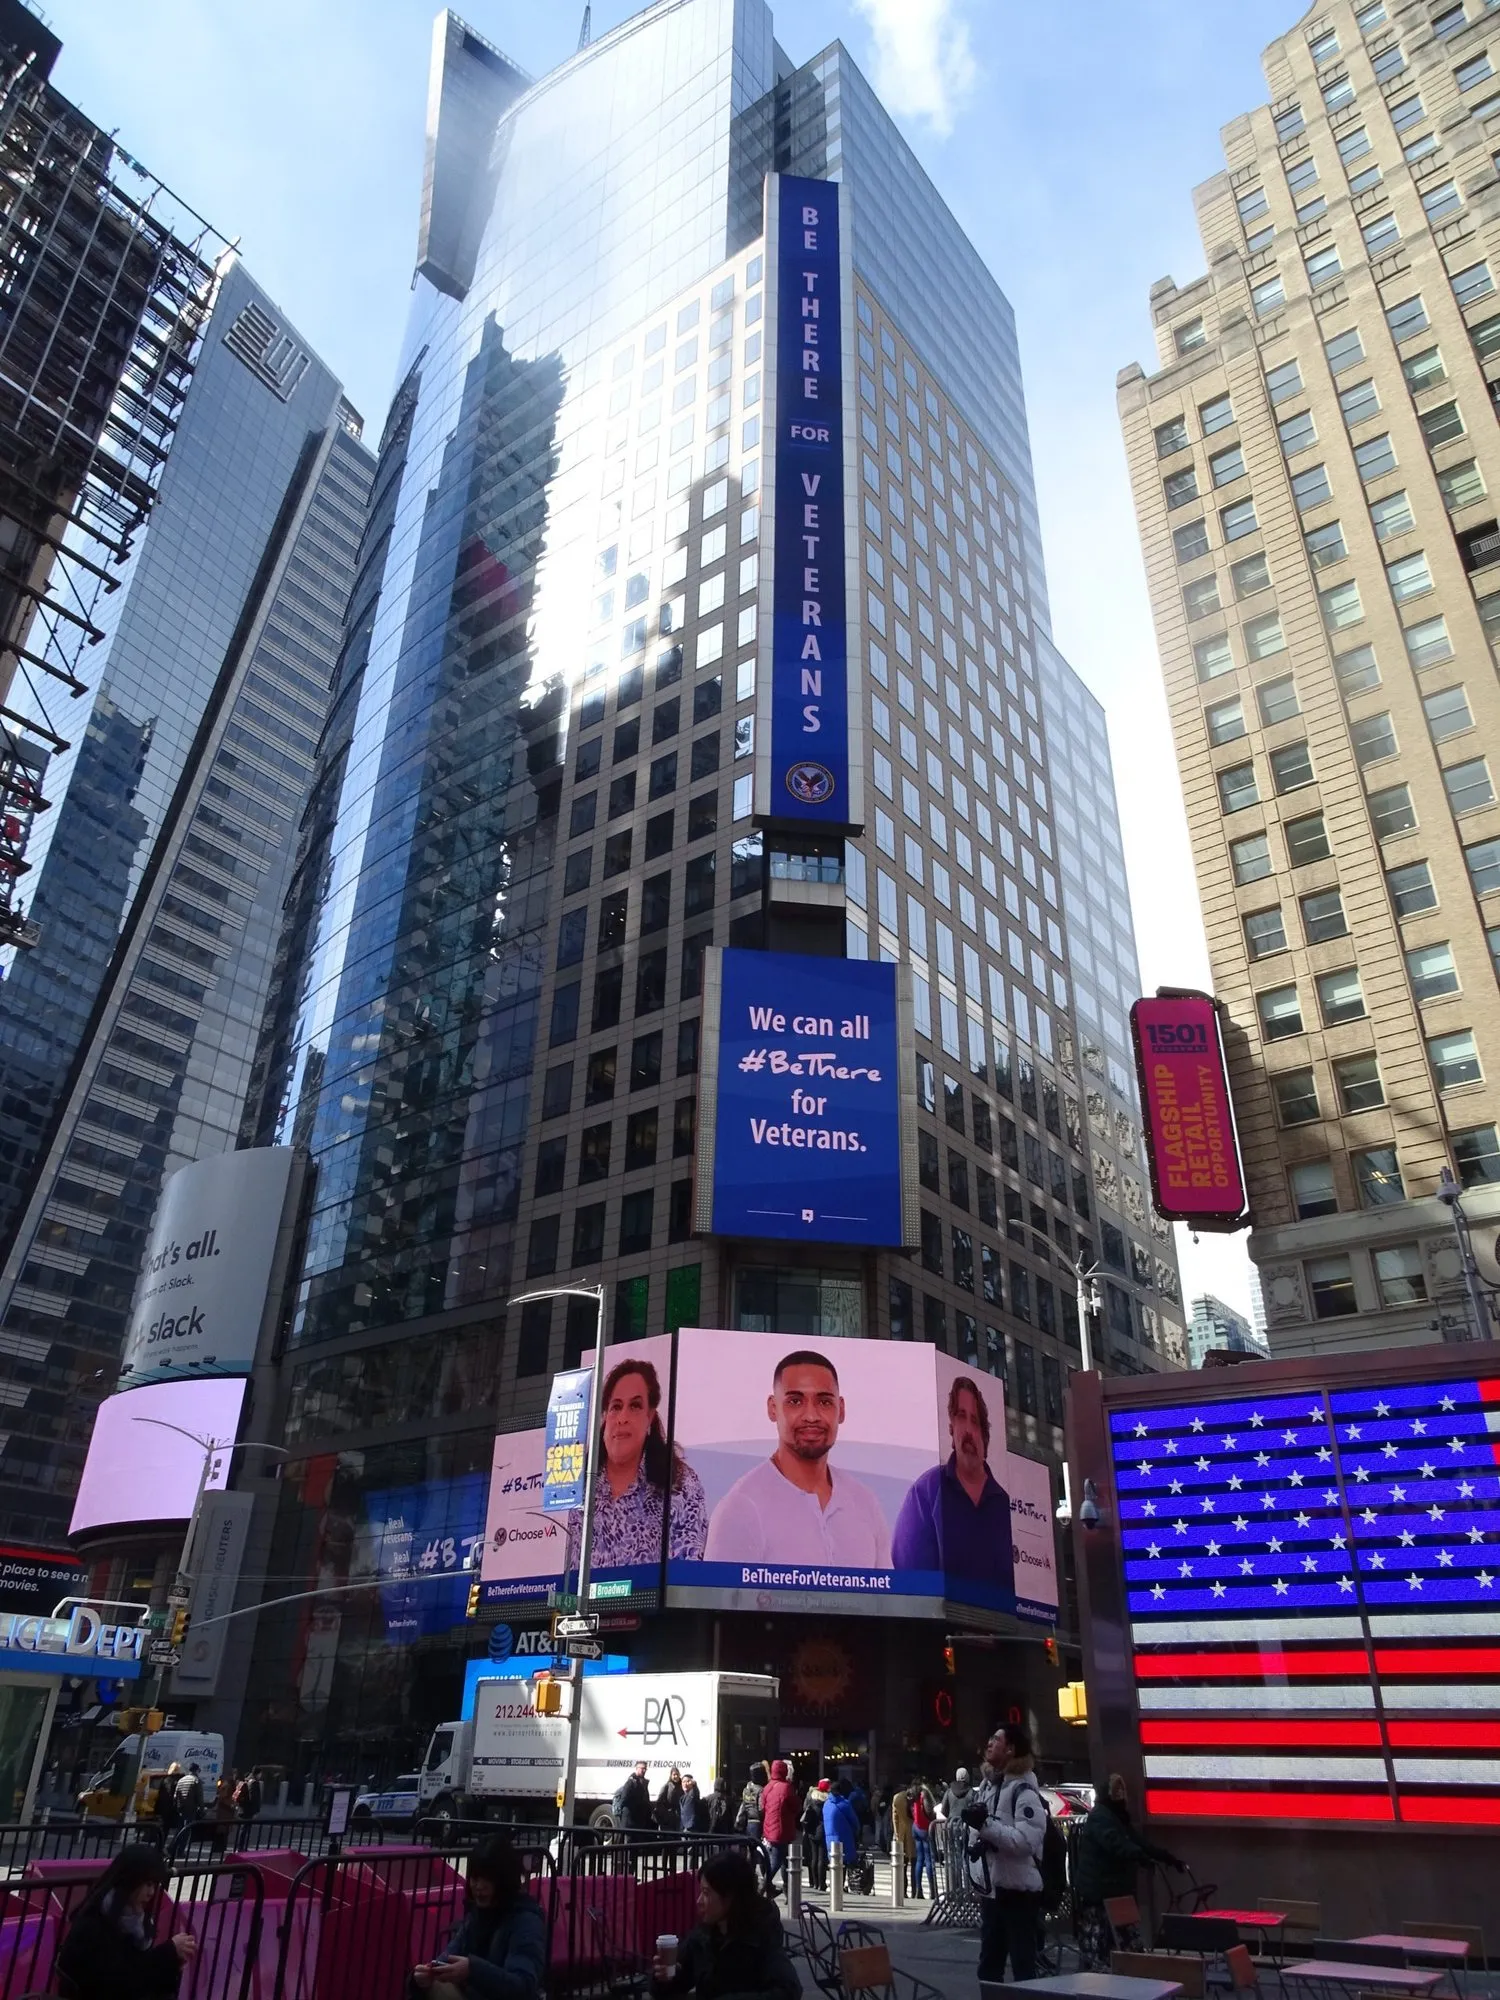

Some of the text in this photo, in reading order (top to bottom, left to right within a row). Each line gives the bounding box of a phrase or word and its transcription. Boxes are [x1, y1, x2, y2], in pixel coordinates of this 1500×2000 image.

[801, 206, 820, 399] BE THERE
[790, 424, 830, 443] FOR
[801, 473, 822, 733] VETERANS
[749, 1006, 869, 1039] We can all
[1145, 1023, 1207, 1044] 1501
[738, 1049, 882, 1082] #BeThere
[791, 1088, 827, 1115] for
[750, 1118, 867, 1152] Veterans.
[1154, 1064, 1190, 1188] FLAGSHIP
[1197, 1065, 1229, 1188] OPPORTUNITY
[1181, 1102, 1212, 1188] RETAIL
[186, 1230, 220, 1260] all.
[147, 1306, 206, 1344] slack
[554, 1426, 578, 1440] STORY
[556, 1410, 580, 1428] TRUE
[547, 1443, 584, 1459] COME
[545, 1468, 582, 1485] AWAY
[215, 1519, 233, 1571] REUTERS
[2, 1563, 36, 1577] place
[37, 1568, 49, 1578] to
[51, 1570, 71, 1581] see
[72, 1573, 80, 1582] a
[742, 1567, 891, 1589] BeThereForVeterans.net
[487, 1582, 557, 1597] BeThereForVeterans.net
[597, 1583, 629, 1597] Broadway
[66, 1606, 152, 1660] DEPT
[561, 1622, 573, 1630] ONE
[580, 1619, 595, 1629] WAY
[643, 1694, 689, 1747] BAR
[606, 1760, 633, 1768] BUSINESS
[653, 1760, 692, 1769] RELOCATION
